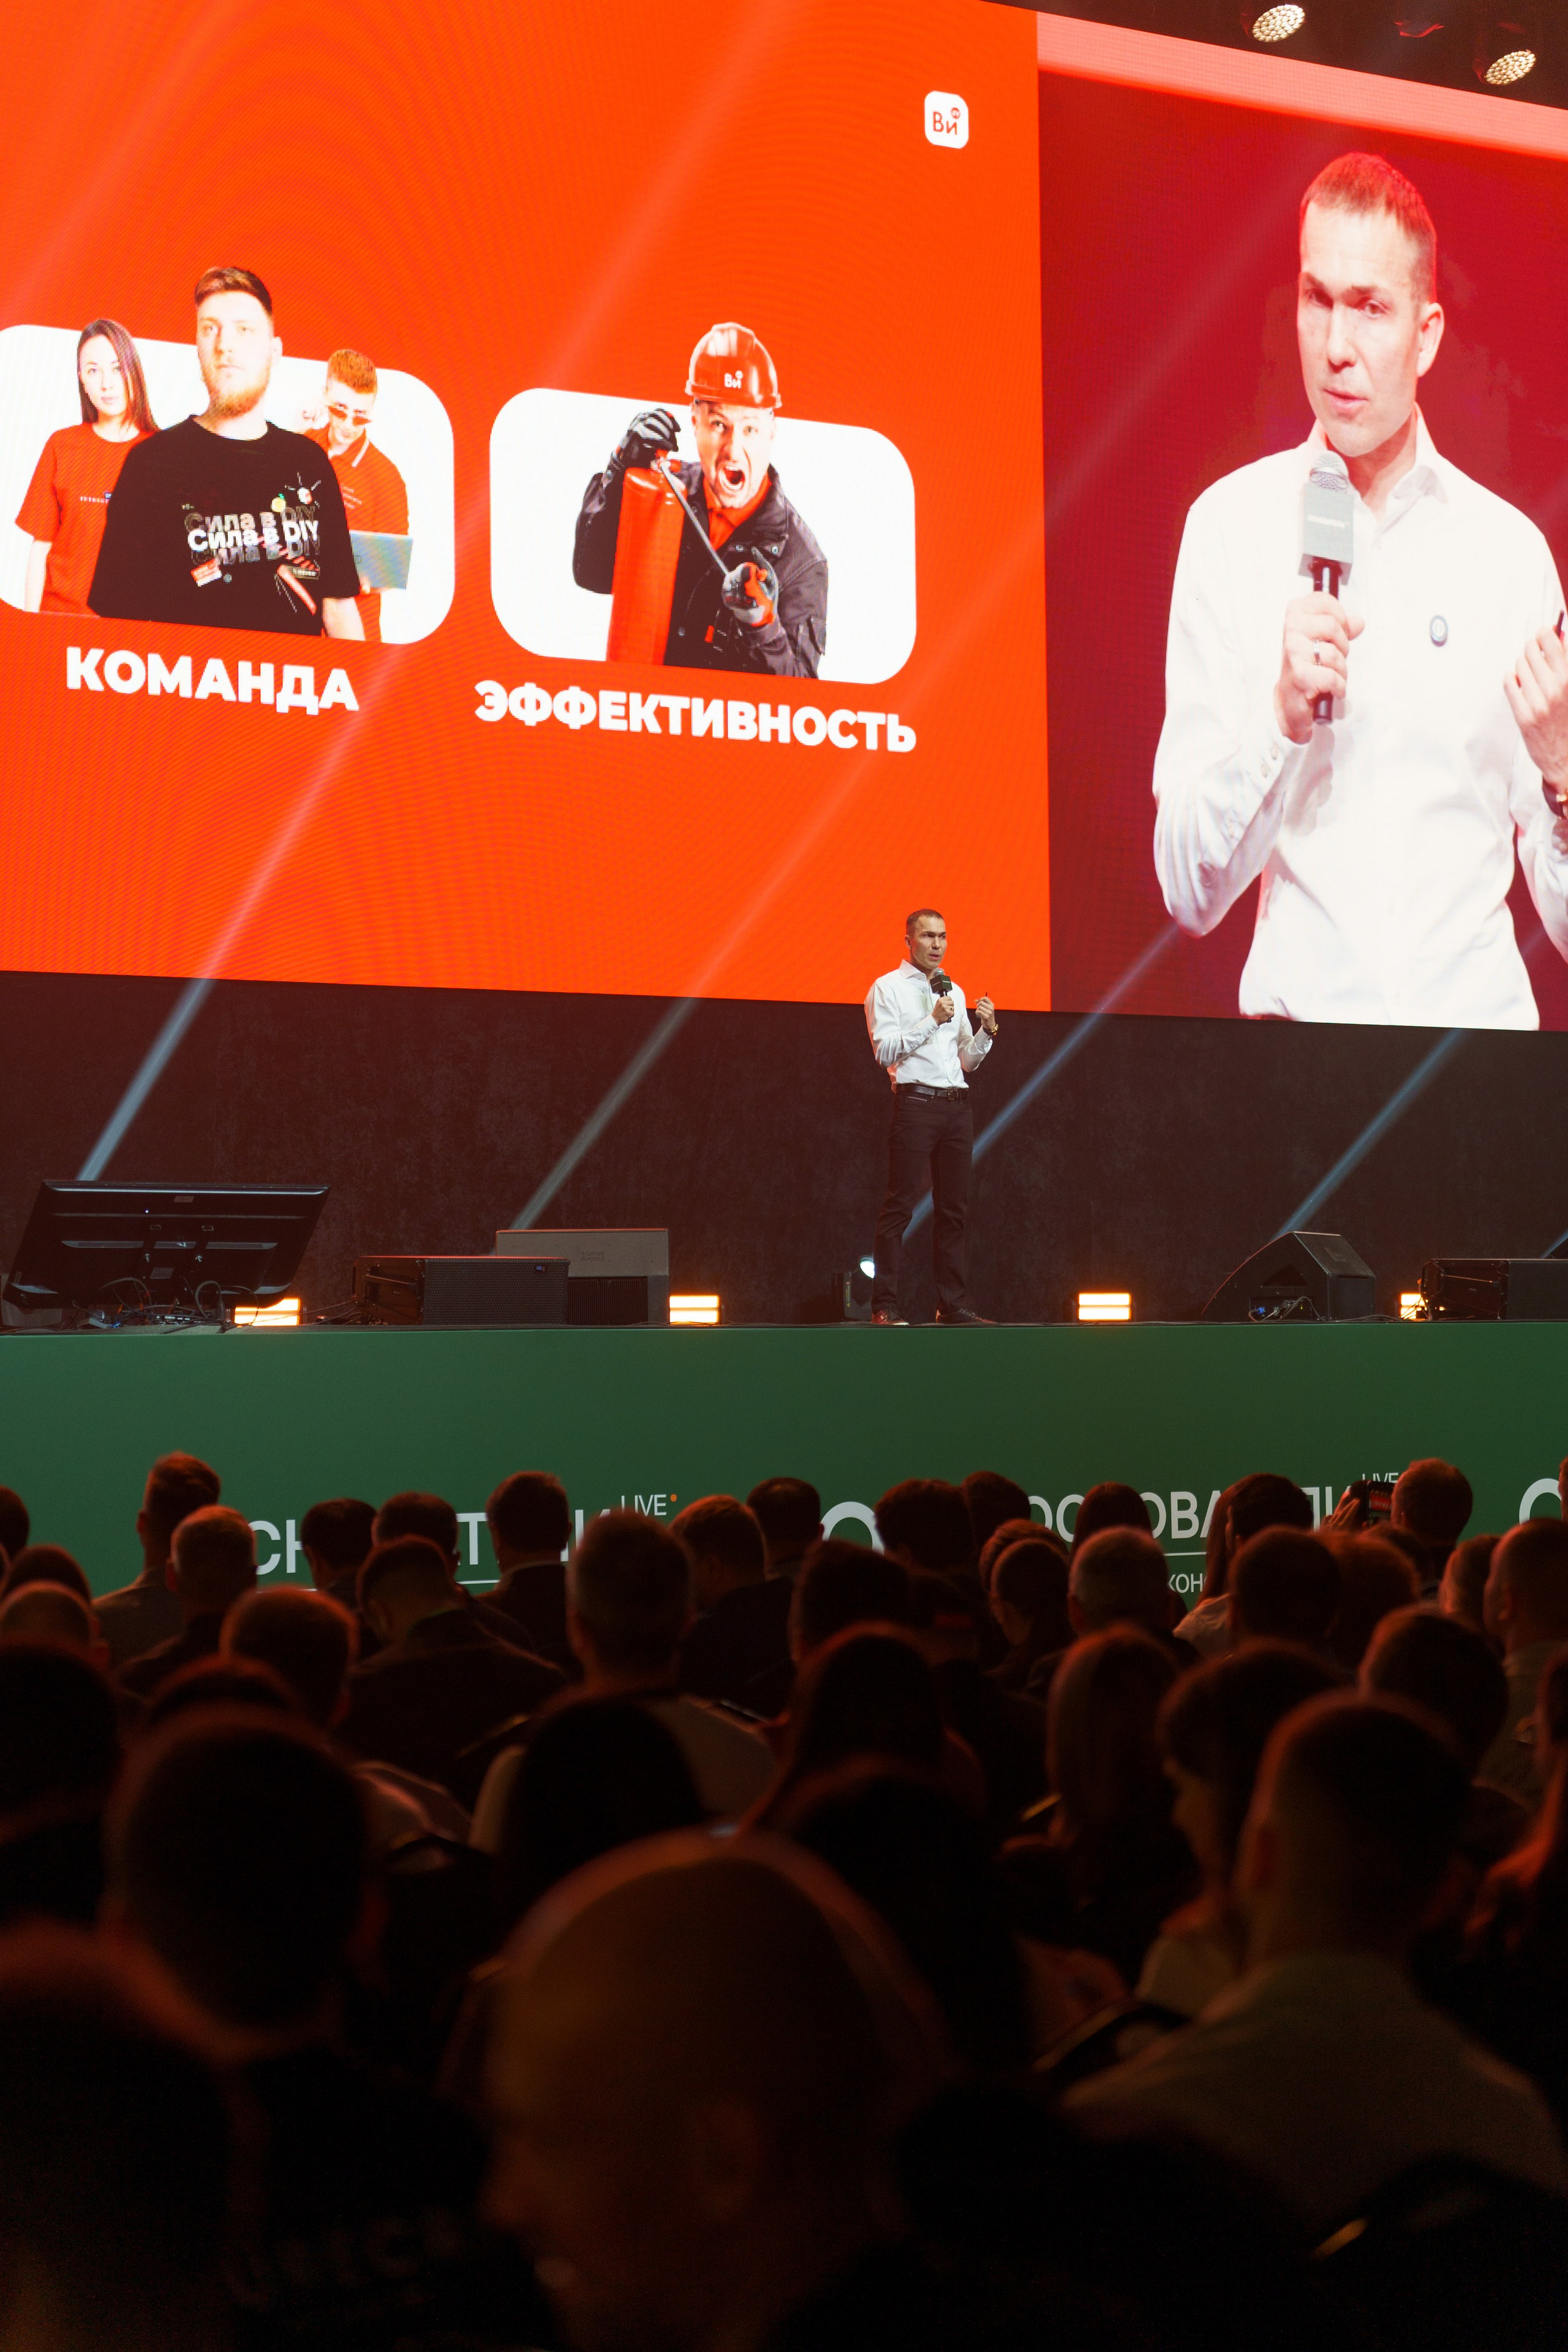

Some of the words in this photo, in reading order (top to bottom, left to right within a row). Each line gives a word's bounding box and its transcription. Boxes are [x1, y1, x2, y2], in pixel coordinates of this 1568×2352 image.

[187, 529, 259, 552] Сила
[262, 527, 279, 545] в
[282, 520, 318, 541] DIY
[66, 646, 360, 715] КОМАНДА
[475, 680, 917, 752] ЭФФЕКТИВНОСТЬ
